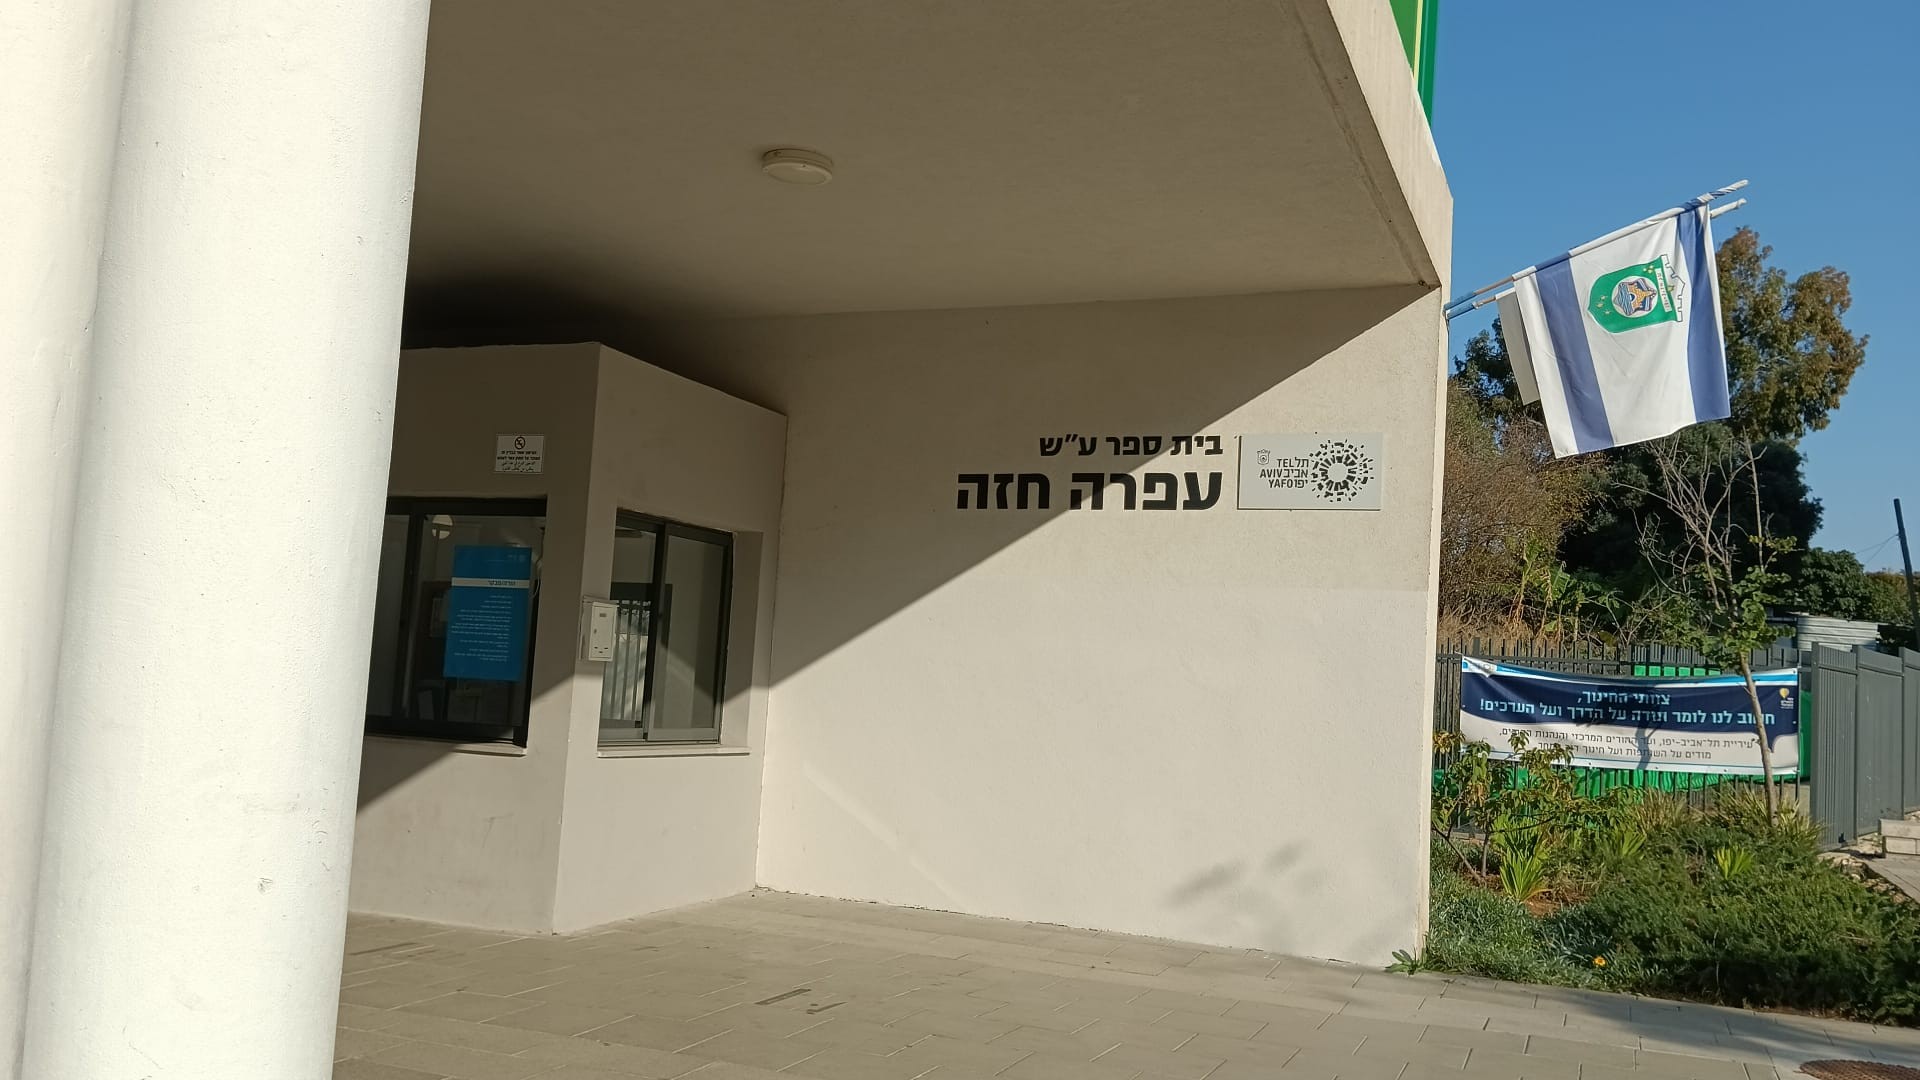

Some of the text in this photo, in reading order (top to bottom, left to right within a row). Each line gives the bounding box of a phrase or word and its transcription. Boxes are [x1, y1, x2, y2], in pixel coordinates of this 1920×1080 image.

[1105, 435, 1162, 456] ספר
[1169, 435, 1224, 456] בית
[1277, 458, 1294, 468] TEL
[1295, 457, 1309, 468] תל
[1260, 468, 1283, 478] AVIV
[1283, 468, 1308, 478] אביב
[1268, 479, 1293, 489] YAFO
[957, 471, 1223, 511] עפרה חזה
[1577, 690, 1628, 704] החינוך,
[1480, 698, 1535, 715] הערכים!
[1539, 702, 1562, 716] ועל
[1567, 706, 1603, 720] הדרך
[1608, 707, 1627, 721] על
[1631, 710, 1668, 722] תודה
[1672, 709, 1707, 723] לומר
[1711, 709, 1733, 724] לנו
[1571, 733, 1603, 742] המרכזי
[1582, 745, 1605, 755] חינוך
[1608, 746, 1623, 756] ועל
[1670, 749, 1682, 758] על
[1685, 750, 1712, 759] מודים
